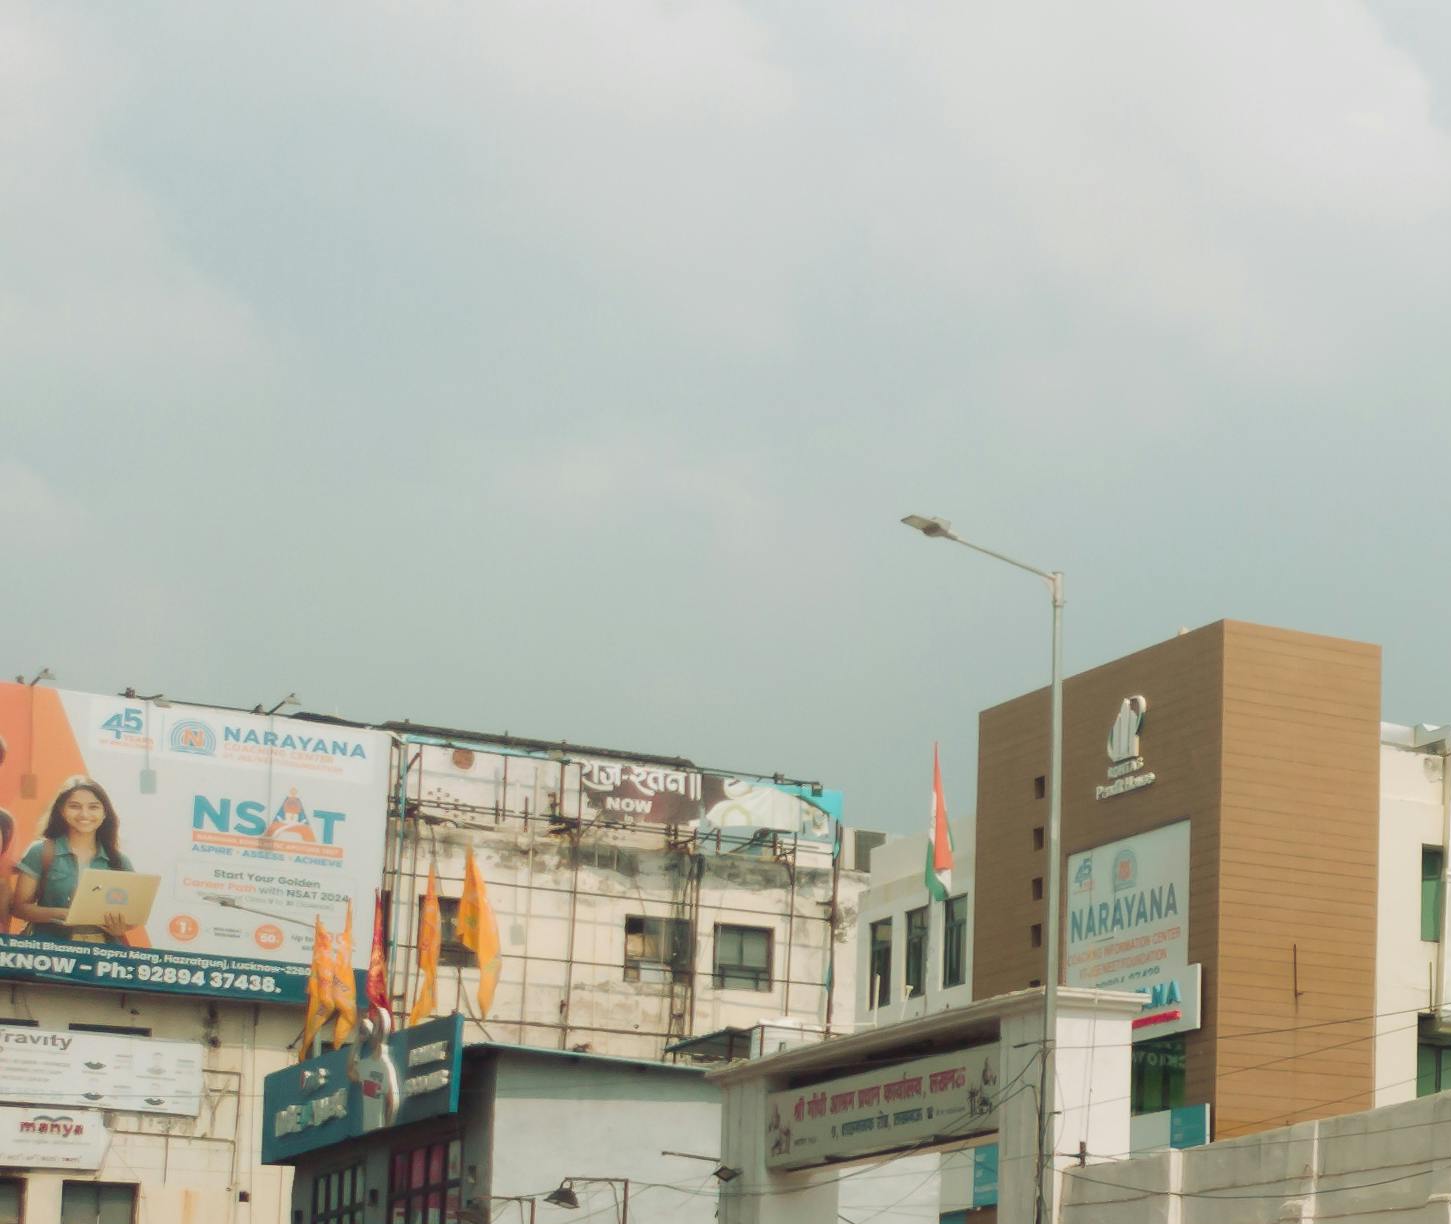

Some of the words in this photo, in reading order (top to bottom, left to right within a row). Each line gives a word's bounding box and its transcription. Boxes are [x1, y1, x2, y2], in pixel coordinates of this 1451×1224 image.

[223, 726, 367, 760] NARAYANA
[193, 786, 346, 845] NSAT
[606, 796, 652, 814] NOW
[192, 843, 233, 856] ASPIRE
[242, 848, 285, 862] ASSESS
[294, 854, 343, 868] ACHIEVE
[214, 869, 244, 880] Start
[248, 872, 274, 883] Your
[278, 876, 321, 889] Golden
[1071, 882, 1178, 943] NARAYANA
[96, 961, 133, 980] Ph:
[138, 965, 206, 987] 92894
[0, 1028, 72, 1050] ravity
[20, 1120, 84, 1138] manya
